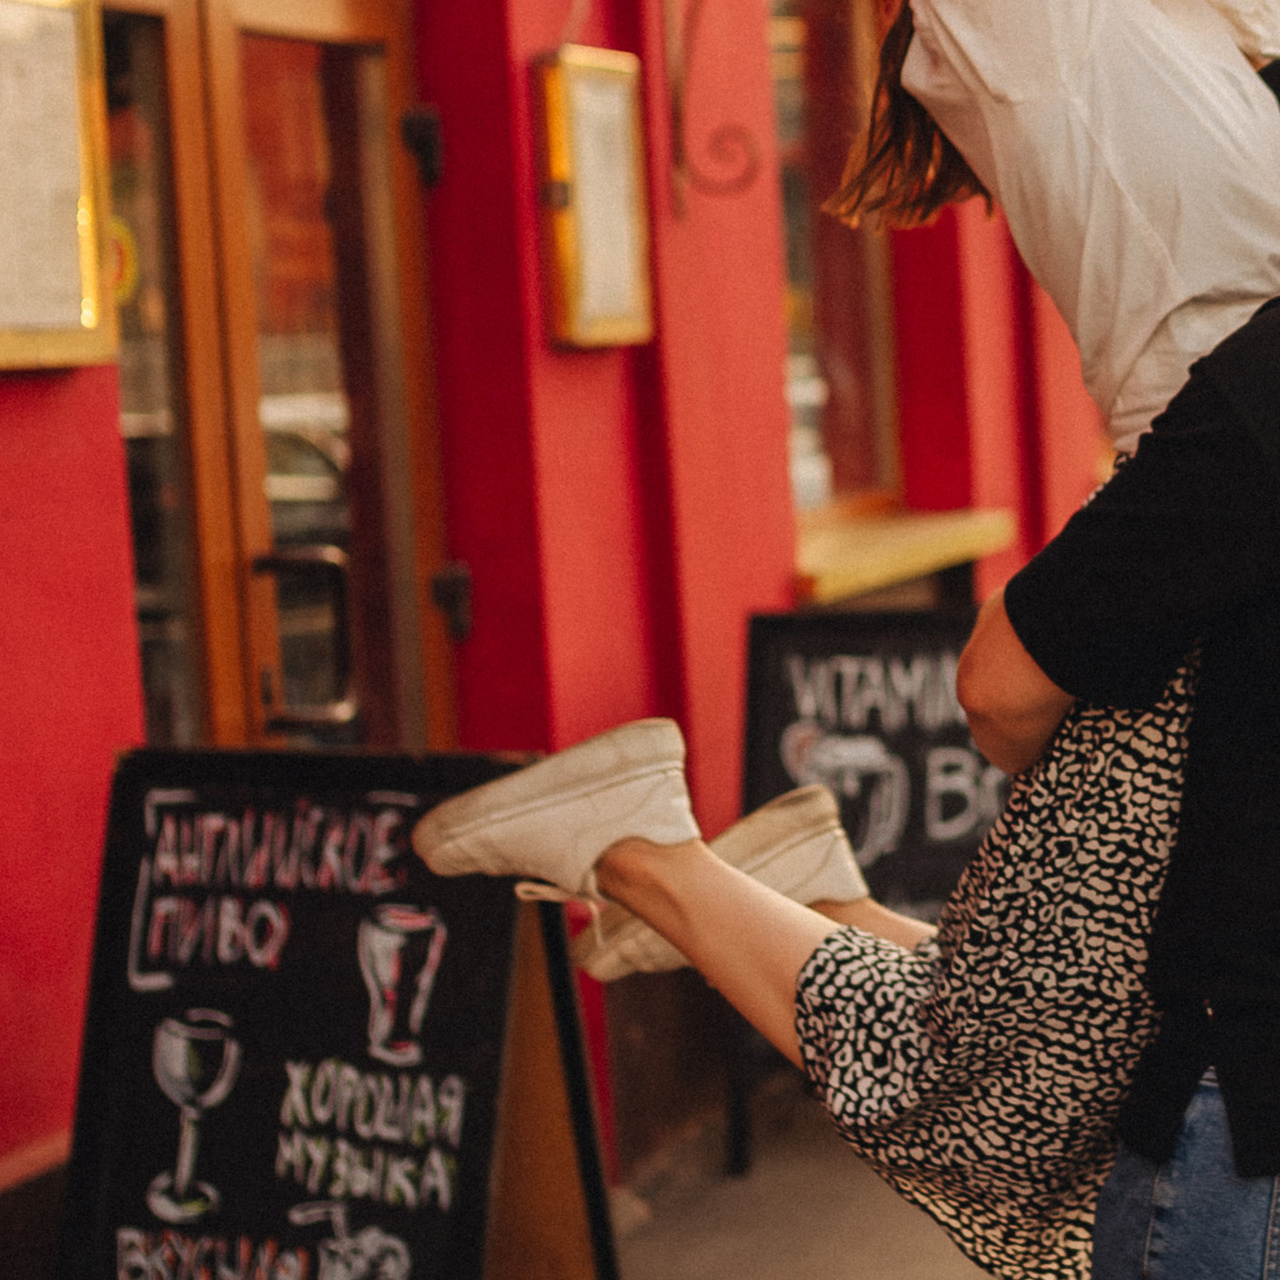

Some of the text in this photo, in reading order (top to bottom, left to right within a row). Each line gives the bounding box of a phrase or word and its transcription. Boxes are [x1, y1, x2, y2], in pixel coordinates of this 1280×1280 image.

[148, 895, 290, 969] ПИВО
[280, 1059, 464, 1149] ХОРОШАЯ
[275, 1130, 456, 1211] МУЗЫКА
